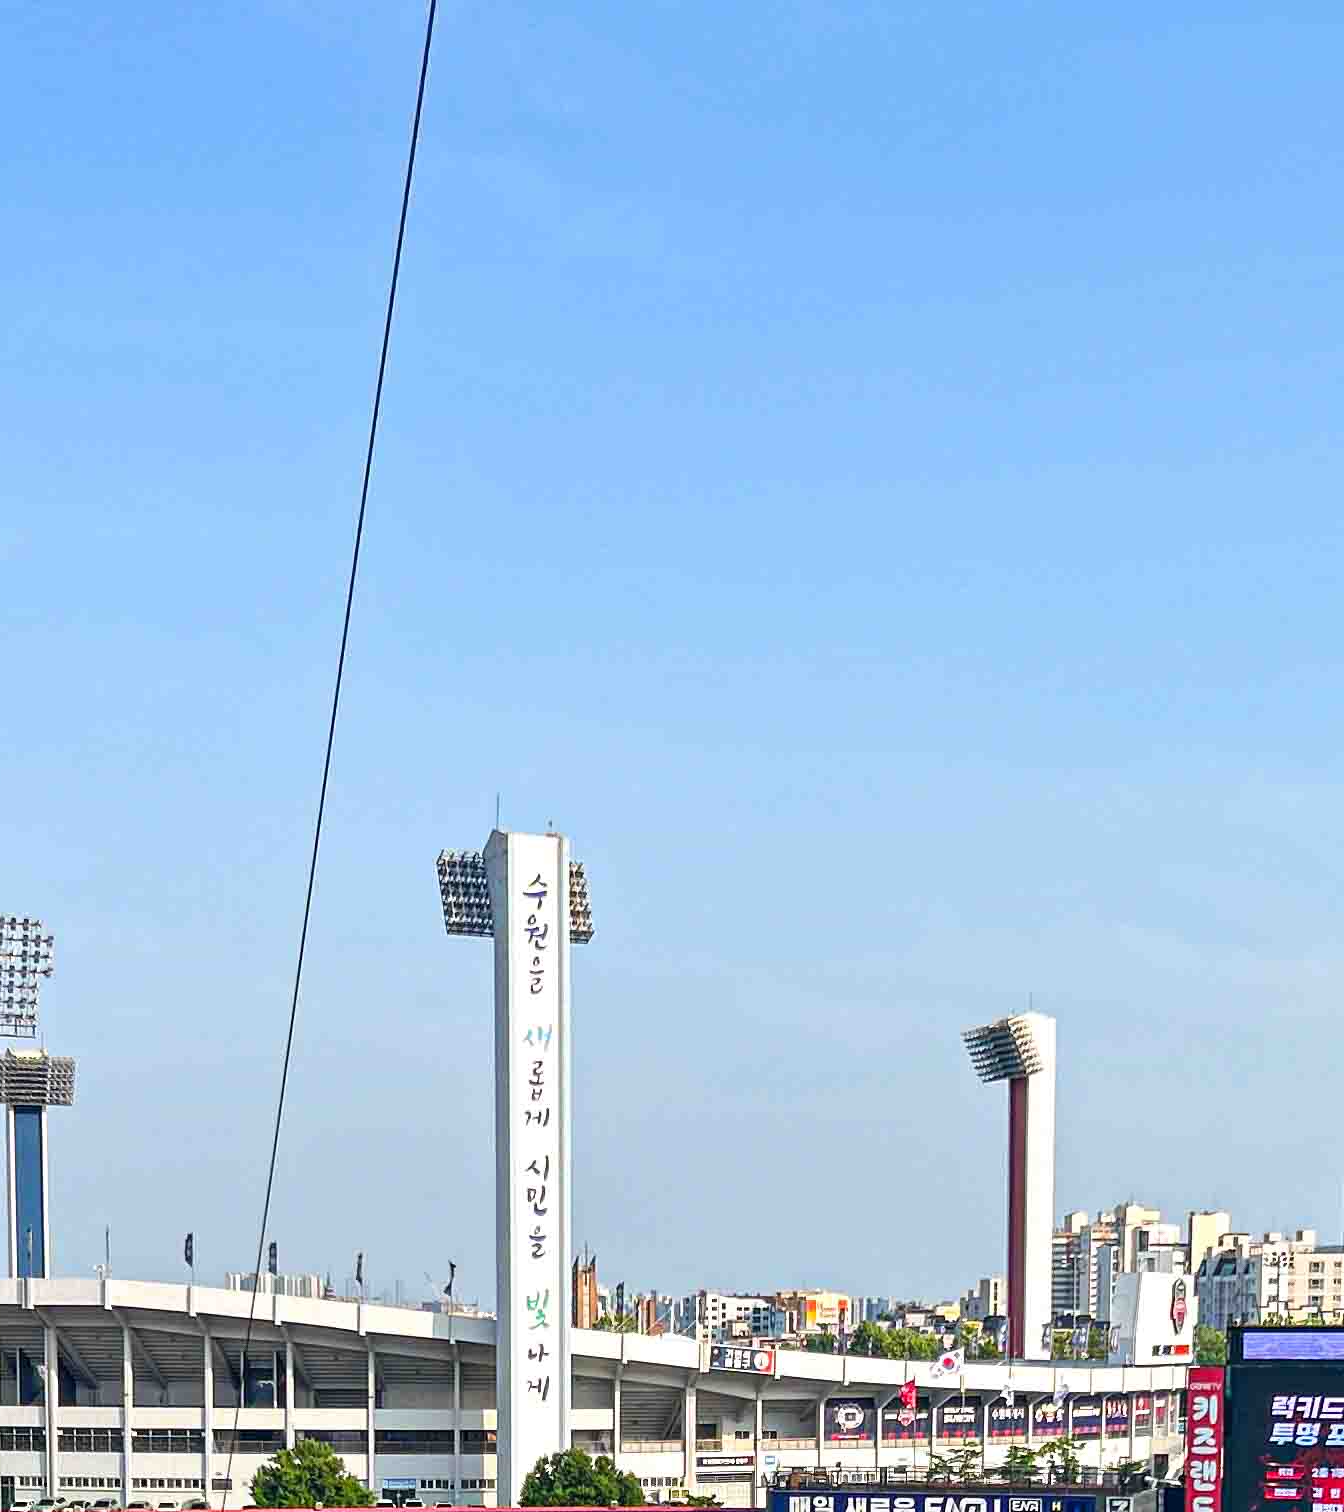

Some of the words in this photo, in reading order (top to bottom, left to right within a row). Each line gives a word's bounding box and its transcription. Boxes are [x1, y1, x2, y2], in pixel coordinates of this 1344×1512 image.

[522, 873, 548, 994] 수원을
[522, 1023, 553, 1127] 새롭게
[525, 1156, 549, 1260] 시민을
[526, 1291, 551, 1402] 빛나게
